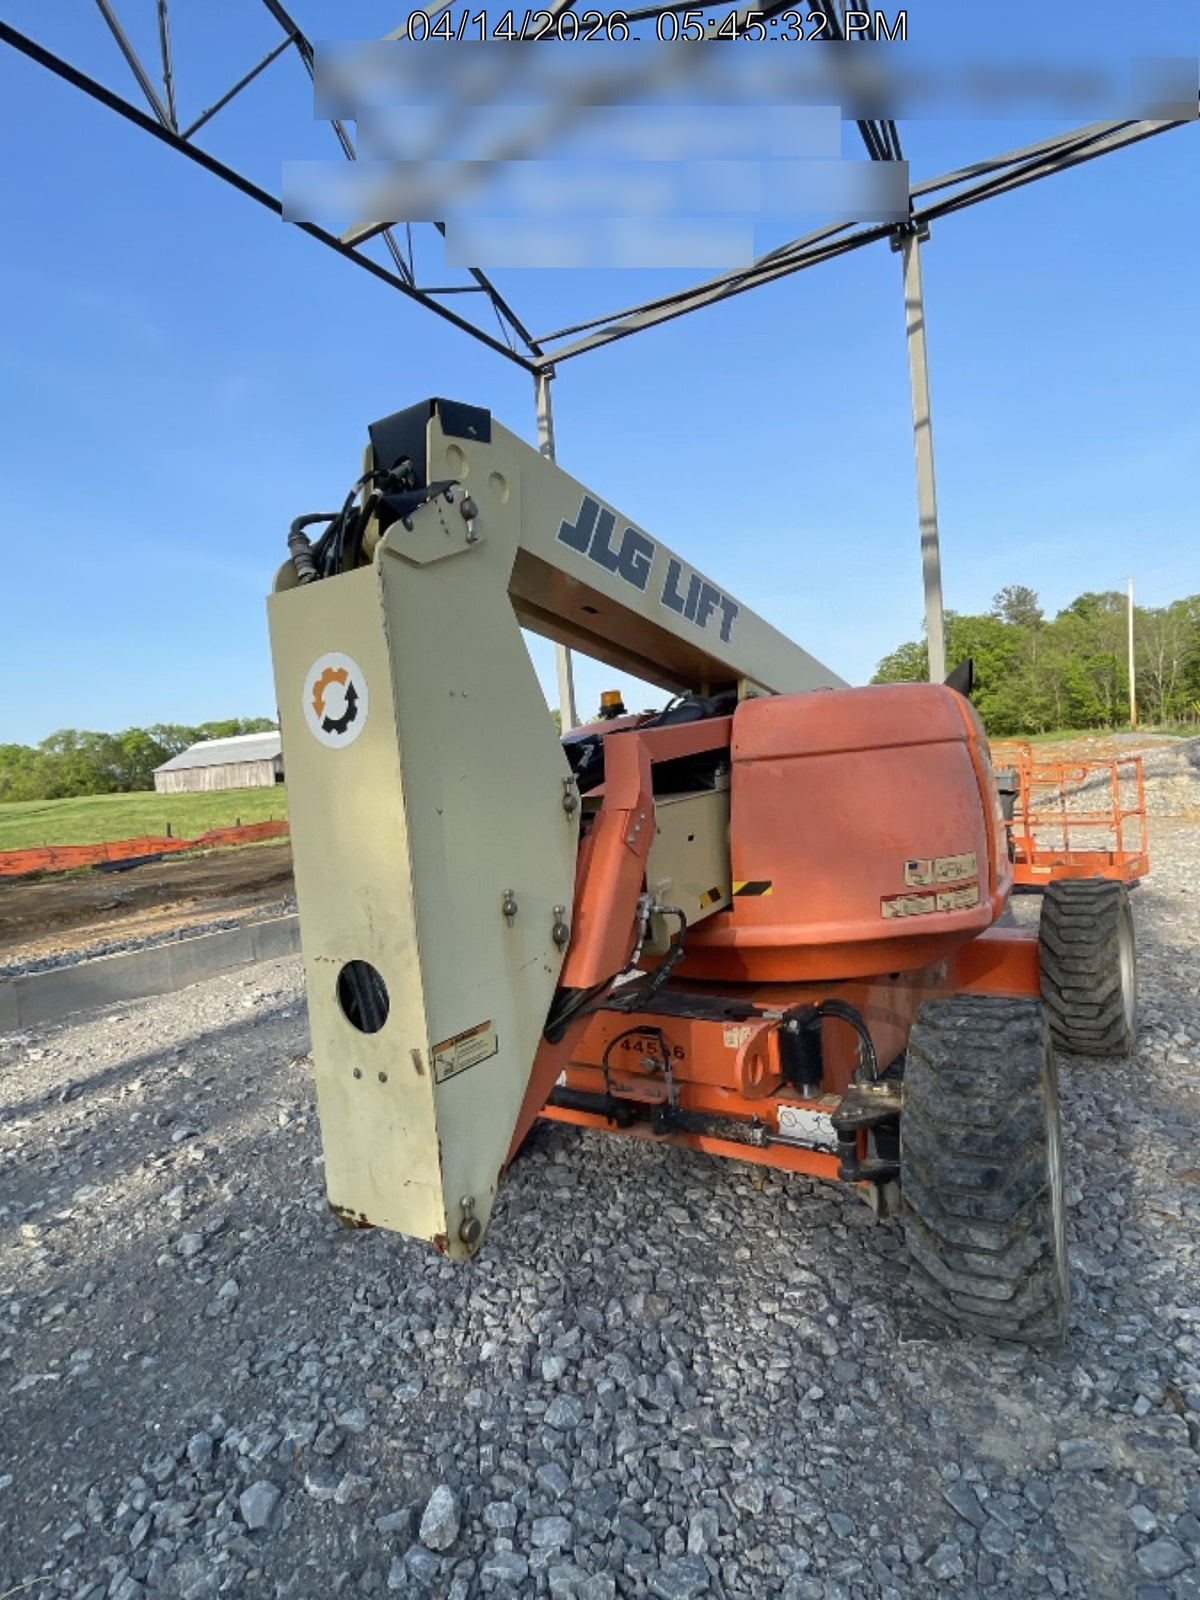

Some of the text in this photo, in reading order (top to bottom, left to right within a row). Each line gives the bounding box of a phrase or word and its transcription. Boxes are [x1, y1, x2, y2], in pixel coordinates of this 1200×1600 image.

[556, 493, 739, 647] JLG LIFT
[620, 1039, 685, 1060] 4456
